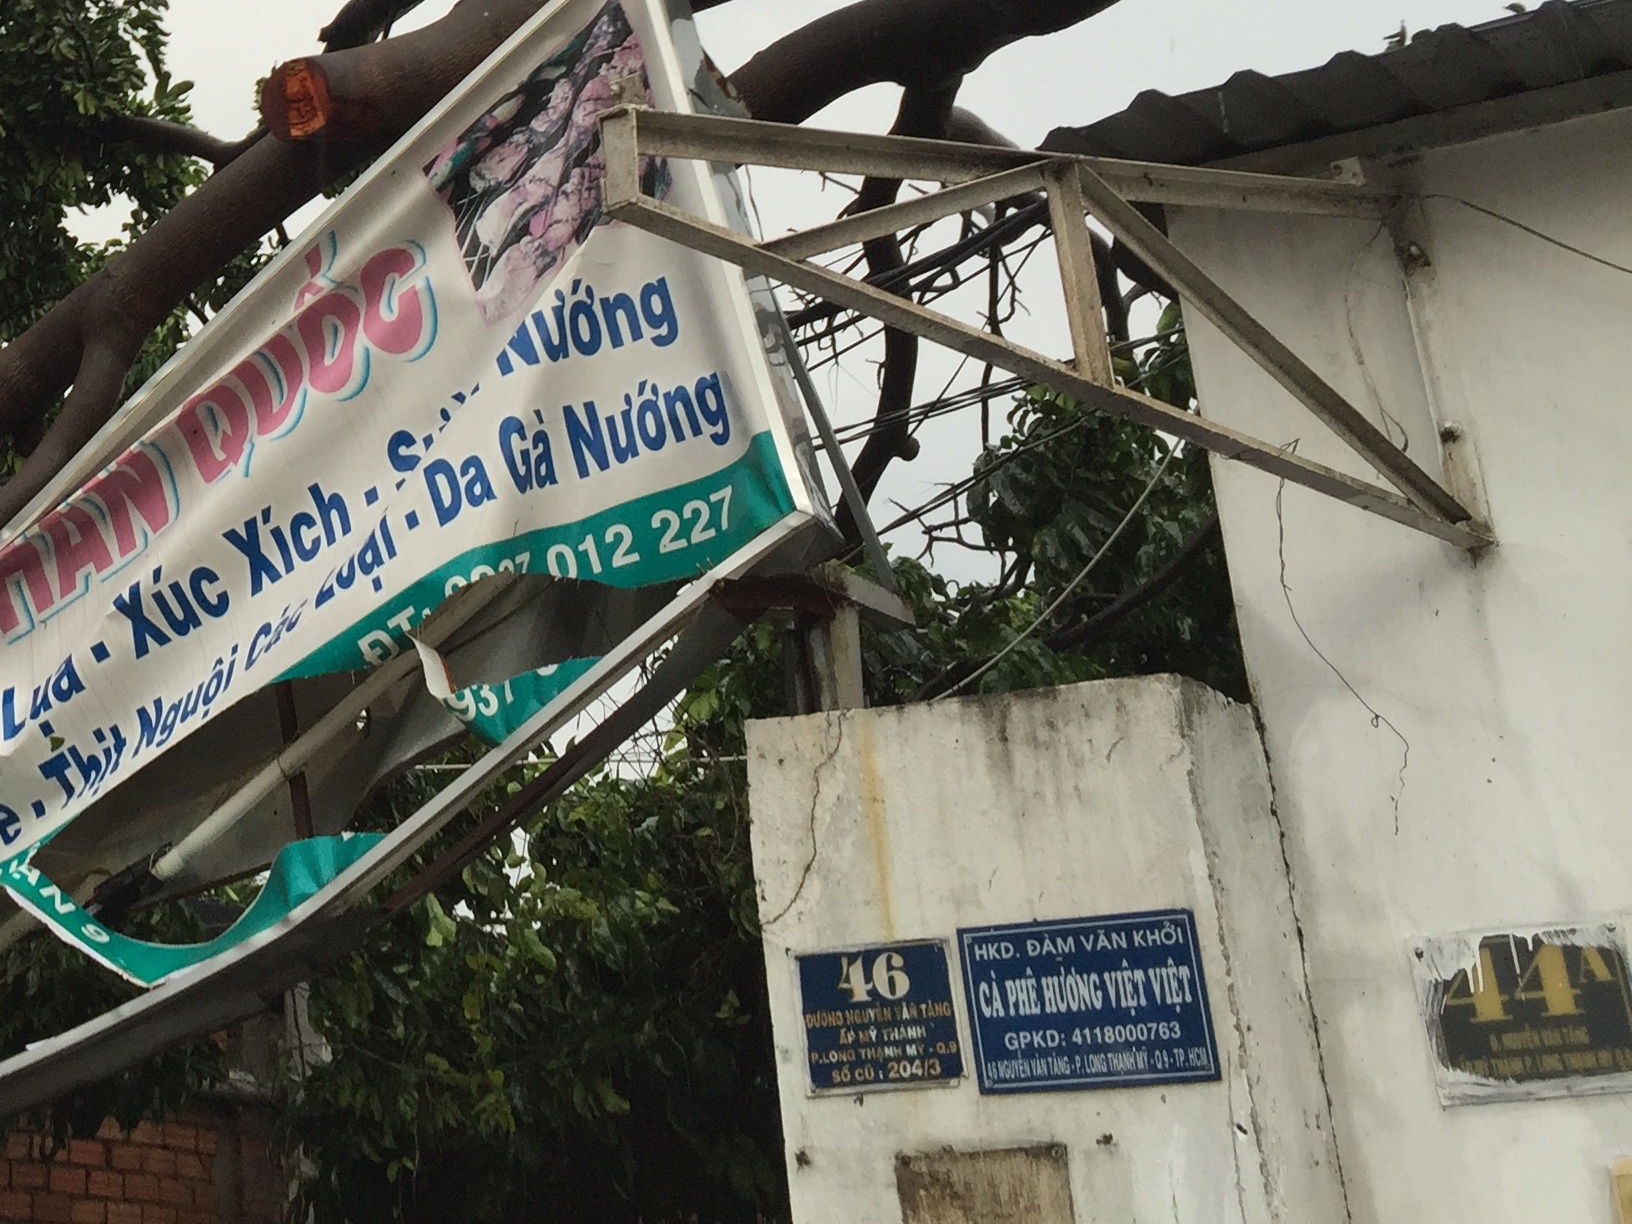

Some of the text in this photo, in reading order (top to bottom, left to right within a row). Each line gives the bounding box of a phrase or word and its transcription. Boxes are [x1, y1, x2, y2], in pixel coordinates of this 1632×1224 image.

[175, 229, 438, 484] QUỐC
[546, 523, 641, 582] 012
[649, 484, 735, 556] 227
[1, 653, 86, 743] Lụa
[112, 563, 231, 661] Xúc
[221, 482, 353, 598] Xích
[37, 722, 129, 811] Thịt
[421, 456, 499, 529] Da
[497, 407, 559, 495] Gà
[562, 370, 733, 481] Nướng
[974, 921, 1185, 963] HKD. ĐÀM VĂN KHỞI
[837, 951, 911, 1004] 46
[977, 956, 1194, 1019] CÀ PHÊ HƯƠNG VIỆT VIỆT
[1004, 1021, 1182, 1052] GPKD: 4118000763
[887, 1057, 942, 1080] 204/3
